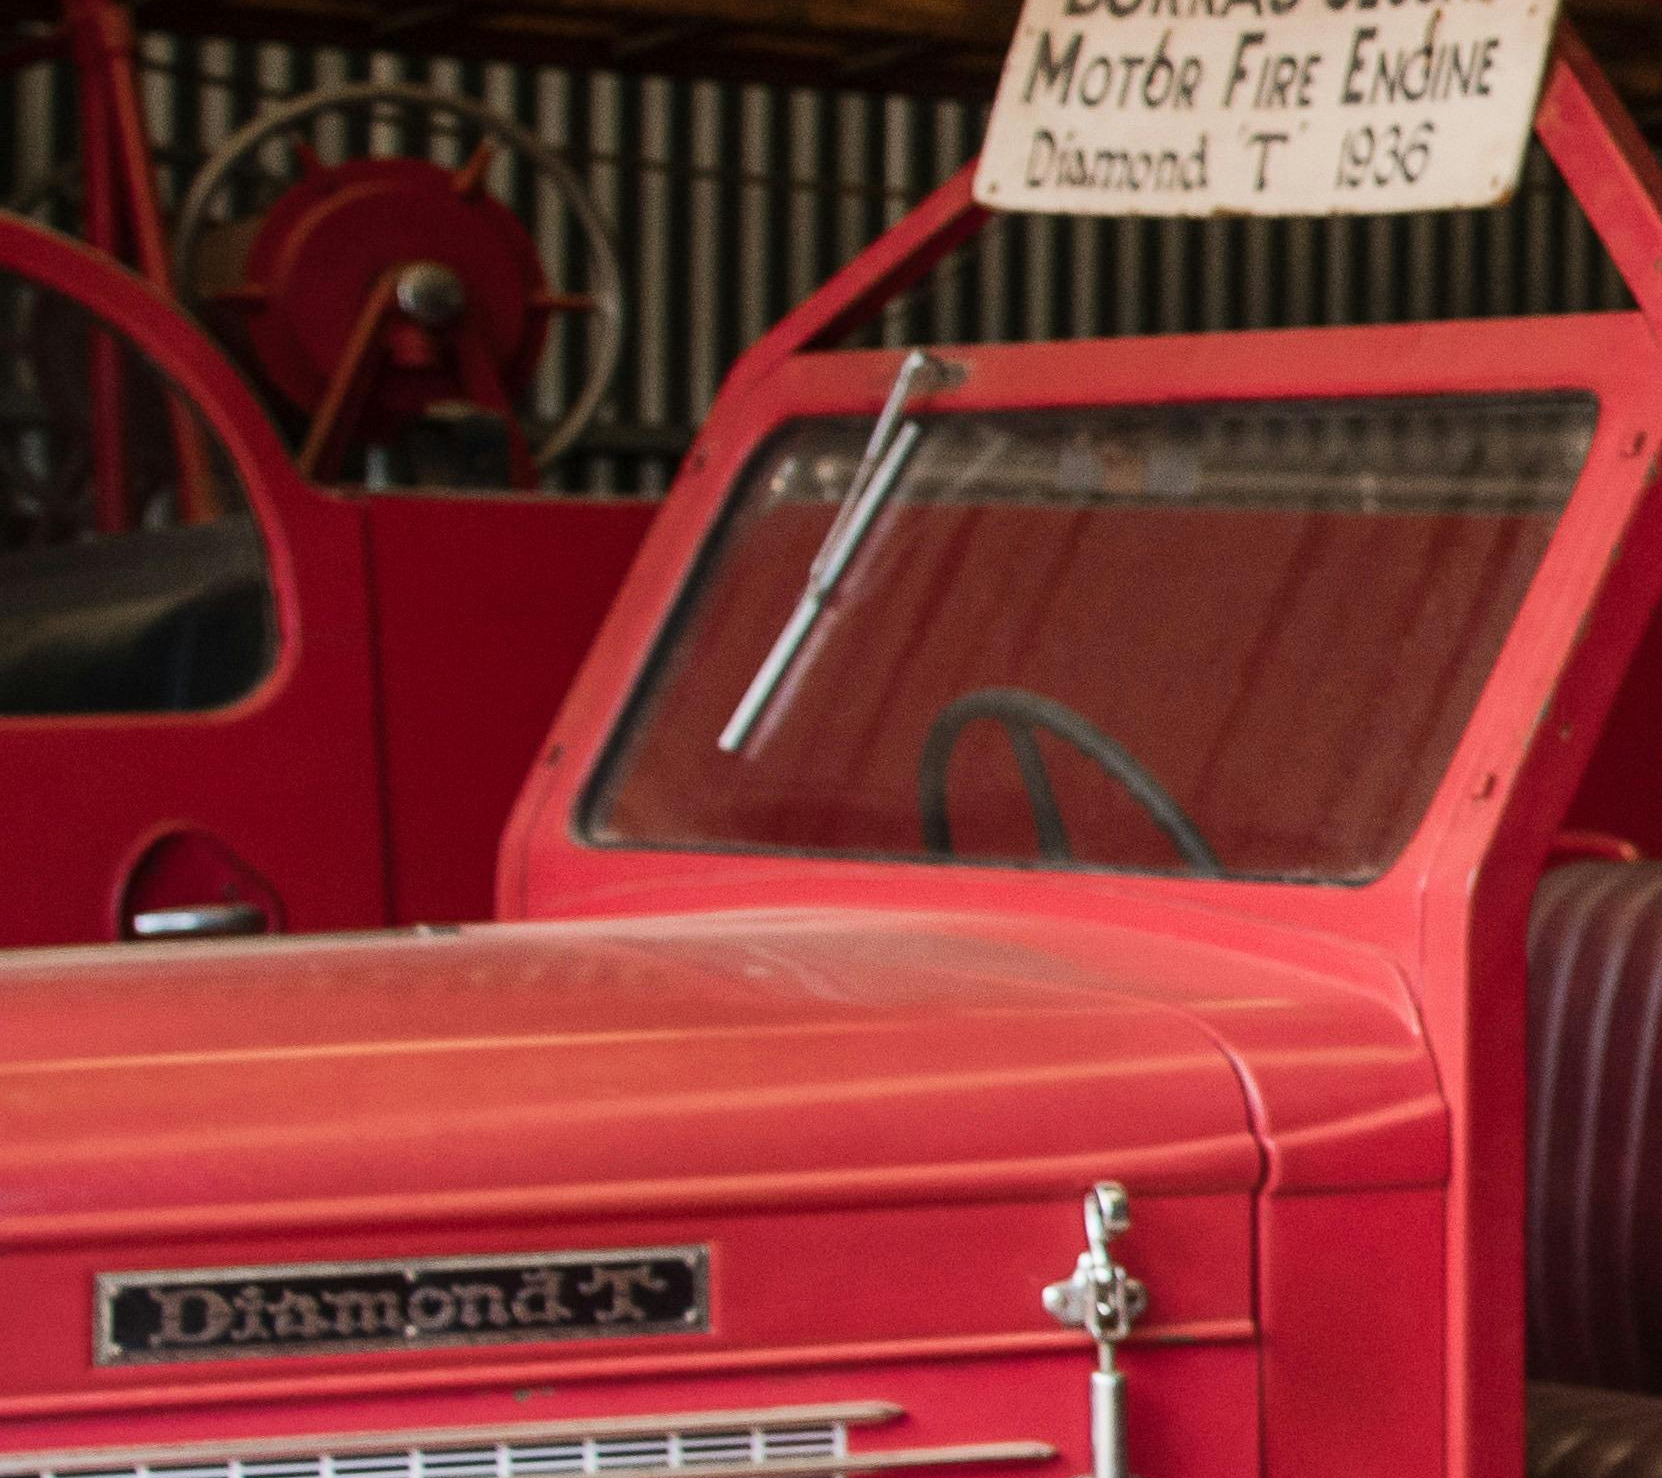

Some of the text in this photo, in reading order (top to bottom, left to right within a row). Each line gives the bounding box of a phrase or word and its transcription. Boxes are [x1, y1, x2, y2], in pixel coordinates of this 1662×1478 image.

[1024, 127, 1209, 192] Diamond
[1336, 120, 1437, 189] 1936
[150, 1264, 669, 1347] Diamond T
